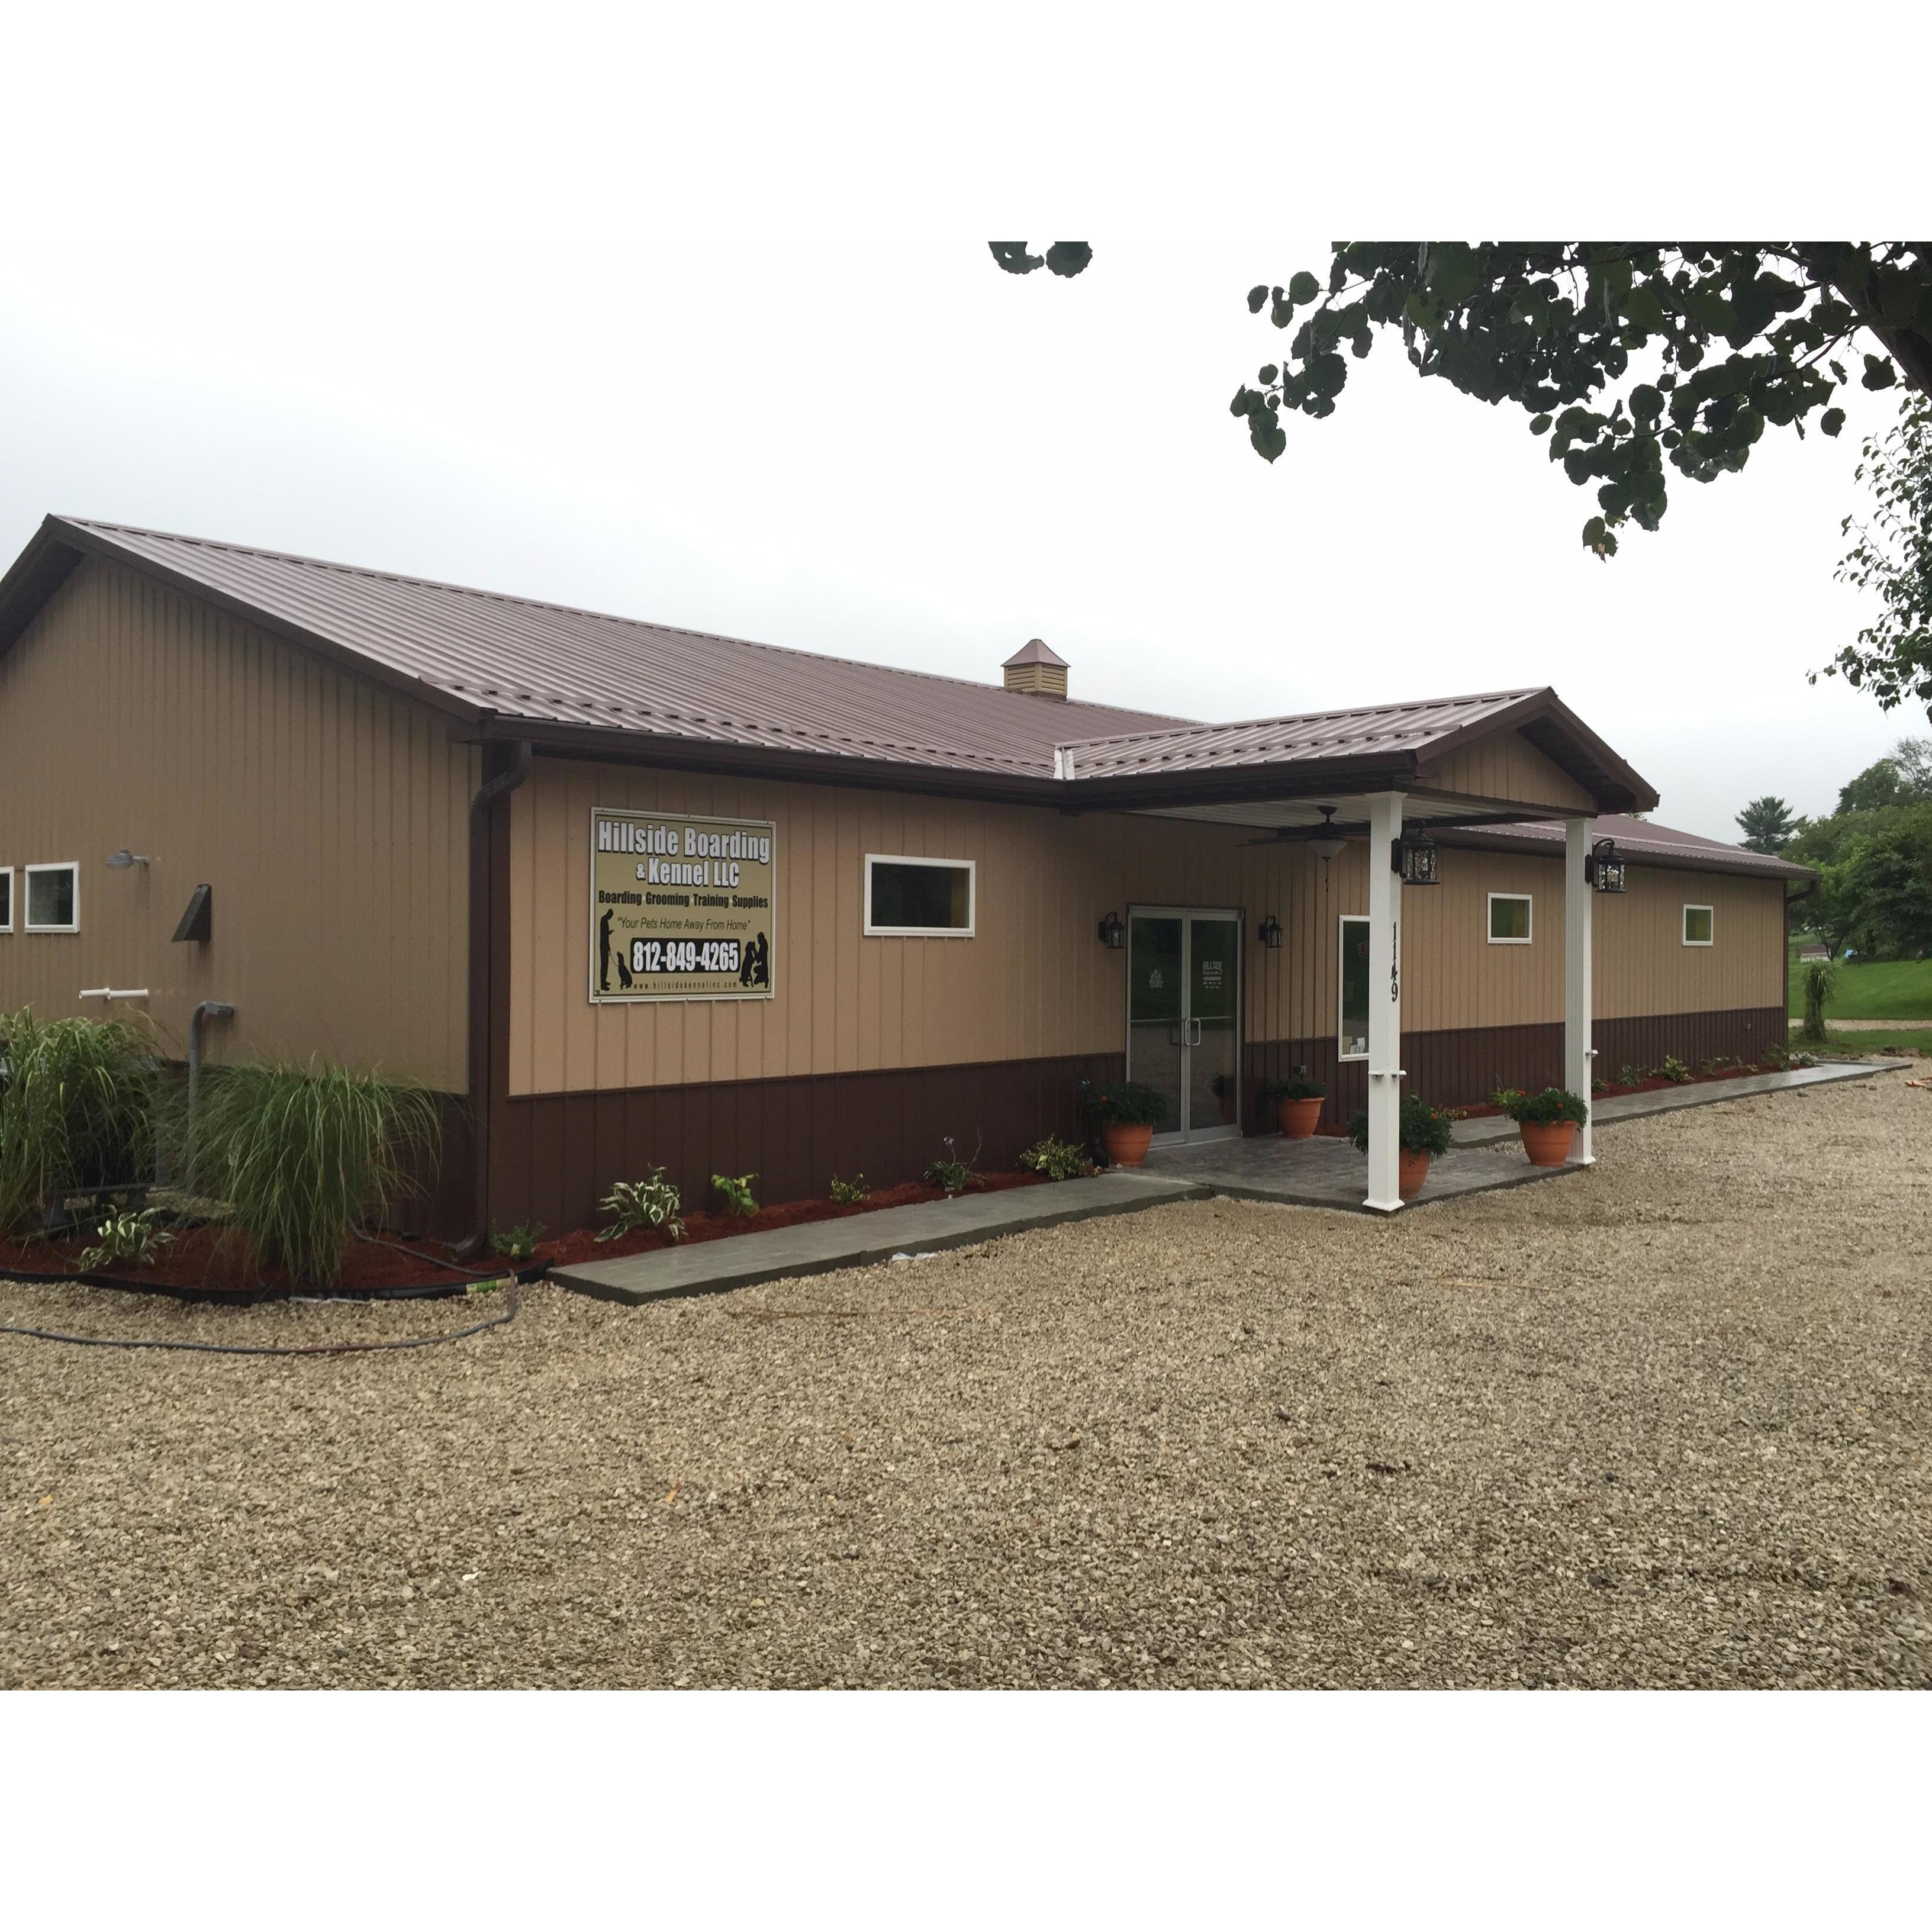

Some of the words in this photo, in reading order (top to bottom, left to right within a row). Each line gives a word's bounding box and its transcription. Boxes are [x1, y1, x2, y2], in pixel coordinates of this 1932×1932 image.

[598, 820, 678, 856] Hillside
[684, 827, 769, 865] Boarding
[636, 862, 646, 881] &
[648, 857, 709, 887] Kennel
[713, 861, 739, 888] LLC
[598, 890, 642, 906] Boarding
[646, 891, 690, 907] Grooming
[693, 893, 729, 909] Training
[732, 895, 768, 910] Supplies
[618, 916, 639, 929] "Your
[640, 917, 658, 929] Pets
[659, 918, 682, 929] Home
[684, 919, 704, 932] Away
[706, 919, 724, 930] From
[726, 919, 751, 930] Home"
[633, 941, 739, 971] 812-849-4265
